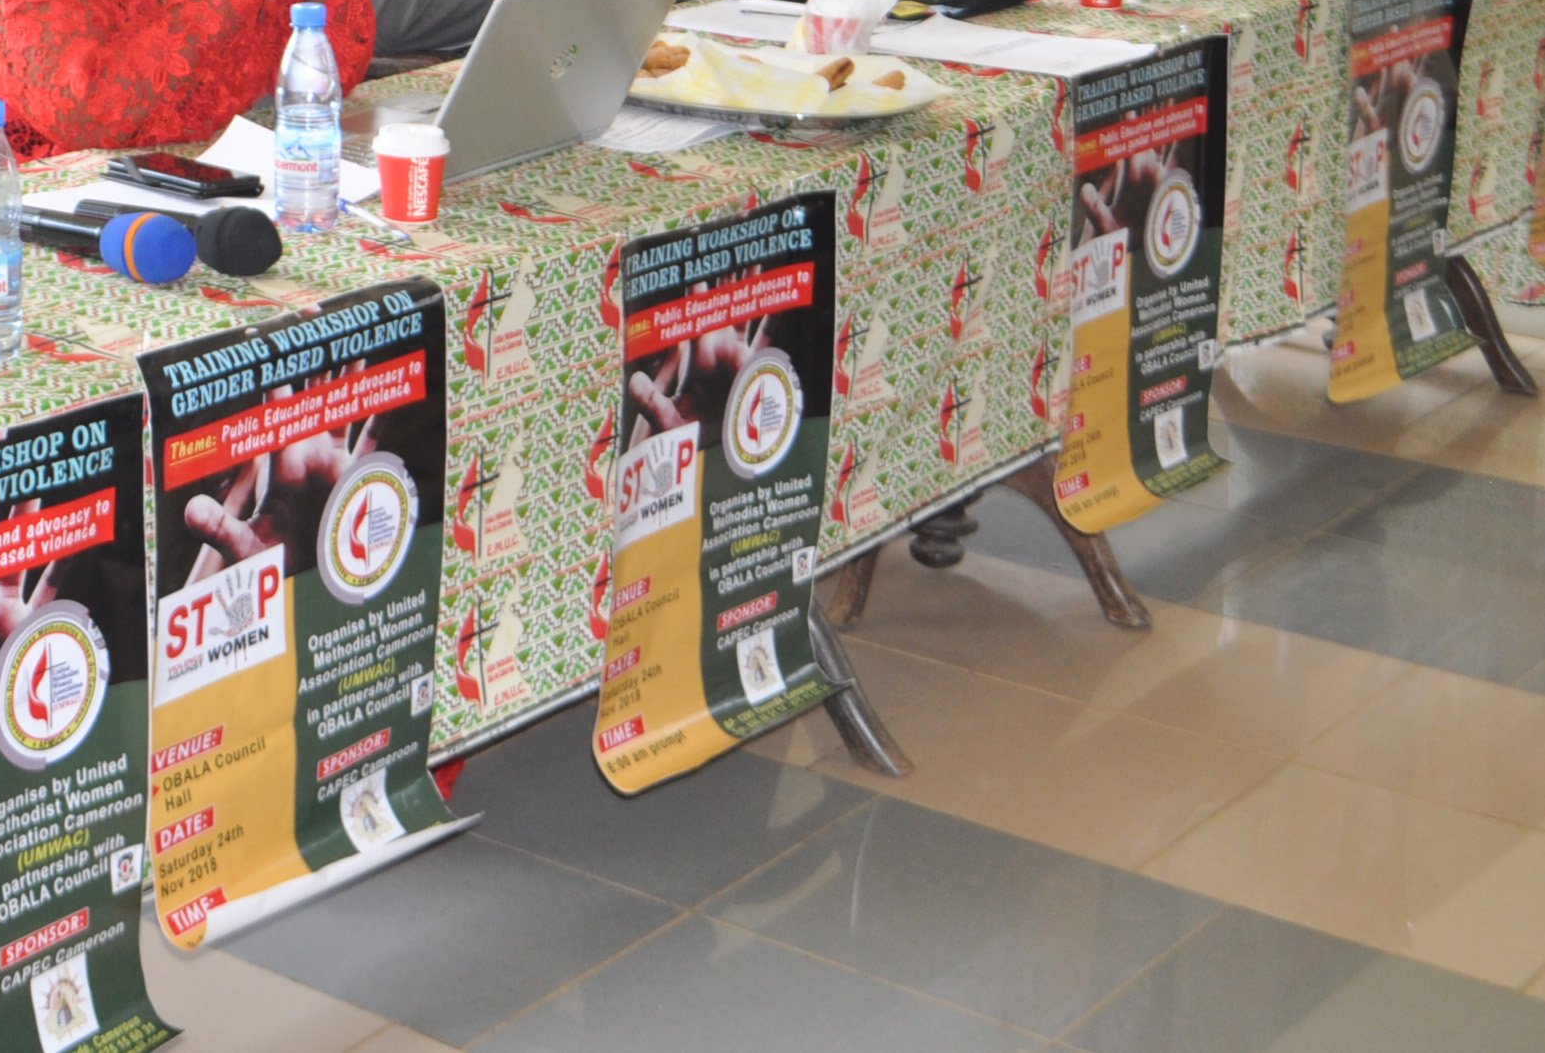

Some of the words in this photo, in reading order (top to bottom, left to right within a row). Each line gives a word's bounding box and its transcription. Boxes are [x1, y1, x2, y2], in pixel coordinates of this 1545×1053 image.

[1078, 72, 1128, 101] TRAINING
[1130, 55, 1185, 85] WORKSHOP
[697, 215, 777, 251] WORKSHOP
[781, 206, 806, 227] ON
[684, 251, 731, 287] BASED
[734, 228, 813, 265] VIOLENCE
[164, 339, 270, 388] TRAINING
[269, 301, 379, 350] WORKSHOP
[387, 290, 415, 314] ON
[172, 367, 254, 417] GENDER
[260, 346, 324, 386] BASED
[330, 312, 422, 362] VIOLENCE
[170, 434, 217, 461] Theme:
[221, 416, 259, 442] Public
[264, 394, 322, 424] Education
[327, 381, 348, 405] and
[353, 367, 403, 396] advocacy
[409, 360, 422, 376] to
[231, 430, 274, 457] reduce
[279, 415, 320, 447] gender
[324, 400, 359, 423] based
[362, 382, 411, 411] violence
[71, 420, 108, 450] ON
[641, 492, 683, 519] WOMEN
[767, 494, 808, 513] Women
[774, 475, 812, 495] United
[26, 508, 92, 540] advocacy
[95, 499, 111, 515] to
[763, 504, 819, 529] Cameroon
[40, 522, 97, 556] violence
[307, 619, 365, 651] Organise
[368, 610, 383, 630] by
[386, 590, 426, 618] United
[313, 632, 376, 669] Methodist
[379, 612, 422, 639] Women
[207, 625, 269, 663] WOMEN
[298, 652, 374, 694] Association
[377, 623, 434, 659] Cameroon
[322, 674, 395, 717] partnership
[398, 662, 422, 683] with
[337, 656, 396, 695] (UMWAC)
[317, 709, 364, 739] OBALA
[366, 681, 410, 711] Council
[156, 731, 219, 766] VENUE:
[322, 730, 387, 775] SPONSOR:
[600, 722, 638, 749] TIME:
[52, 777, 72, 800] by
[76, 754, 128, 784] United
[162, 759, 211, 792] OBALA
[215, 737, 266, 770] Council
[317, 769, 359, 800] CAPEC
[64, 794, 143, 831] Cameroon
[66, 780, 124, 808] Women
[165, 789, 192, 812] Hall
[17, 828, 91, 872] (UMWAC)
[159, 812, 209, 850] DATE:
[159, 842, 213, 878] Saturday
[217, 825, 244, 848] 24th
[2, 848, 88, 902] partnership
[94, 833, 125, 857] with
[54, 858, 109, 892] Council
[160, 875, 186, 899] Nov
[189, 857, 218, 885] 2018
[1, 957, 51, 994] CAPEC
[55, 920, 125, 964] Cameroon
[5, 911, 88, 963] SPONSOR:
